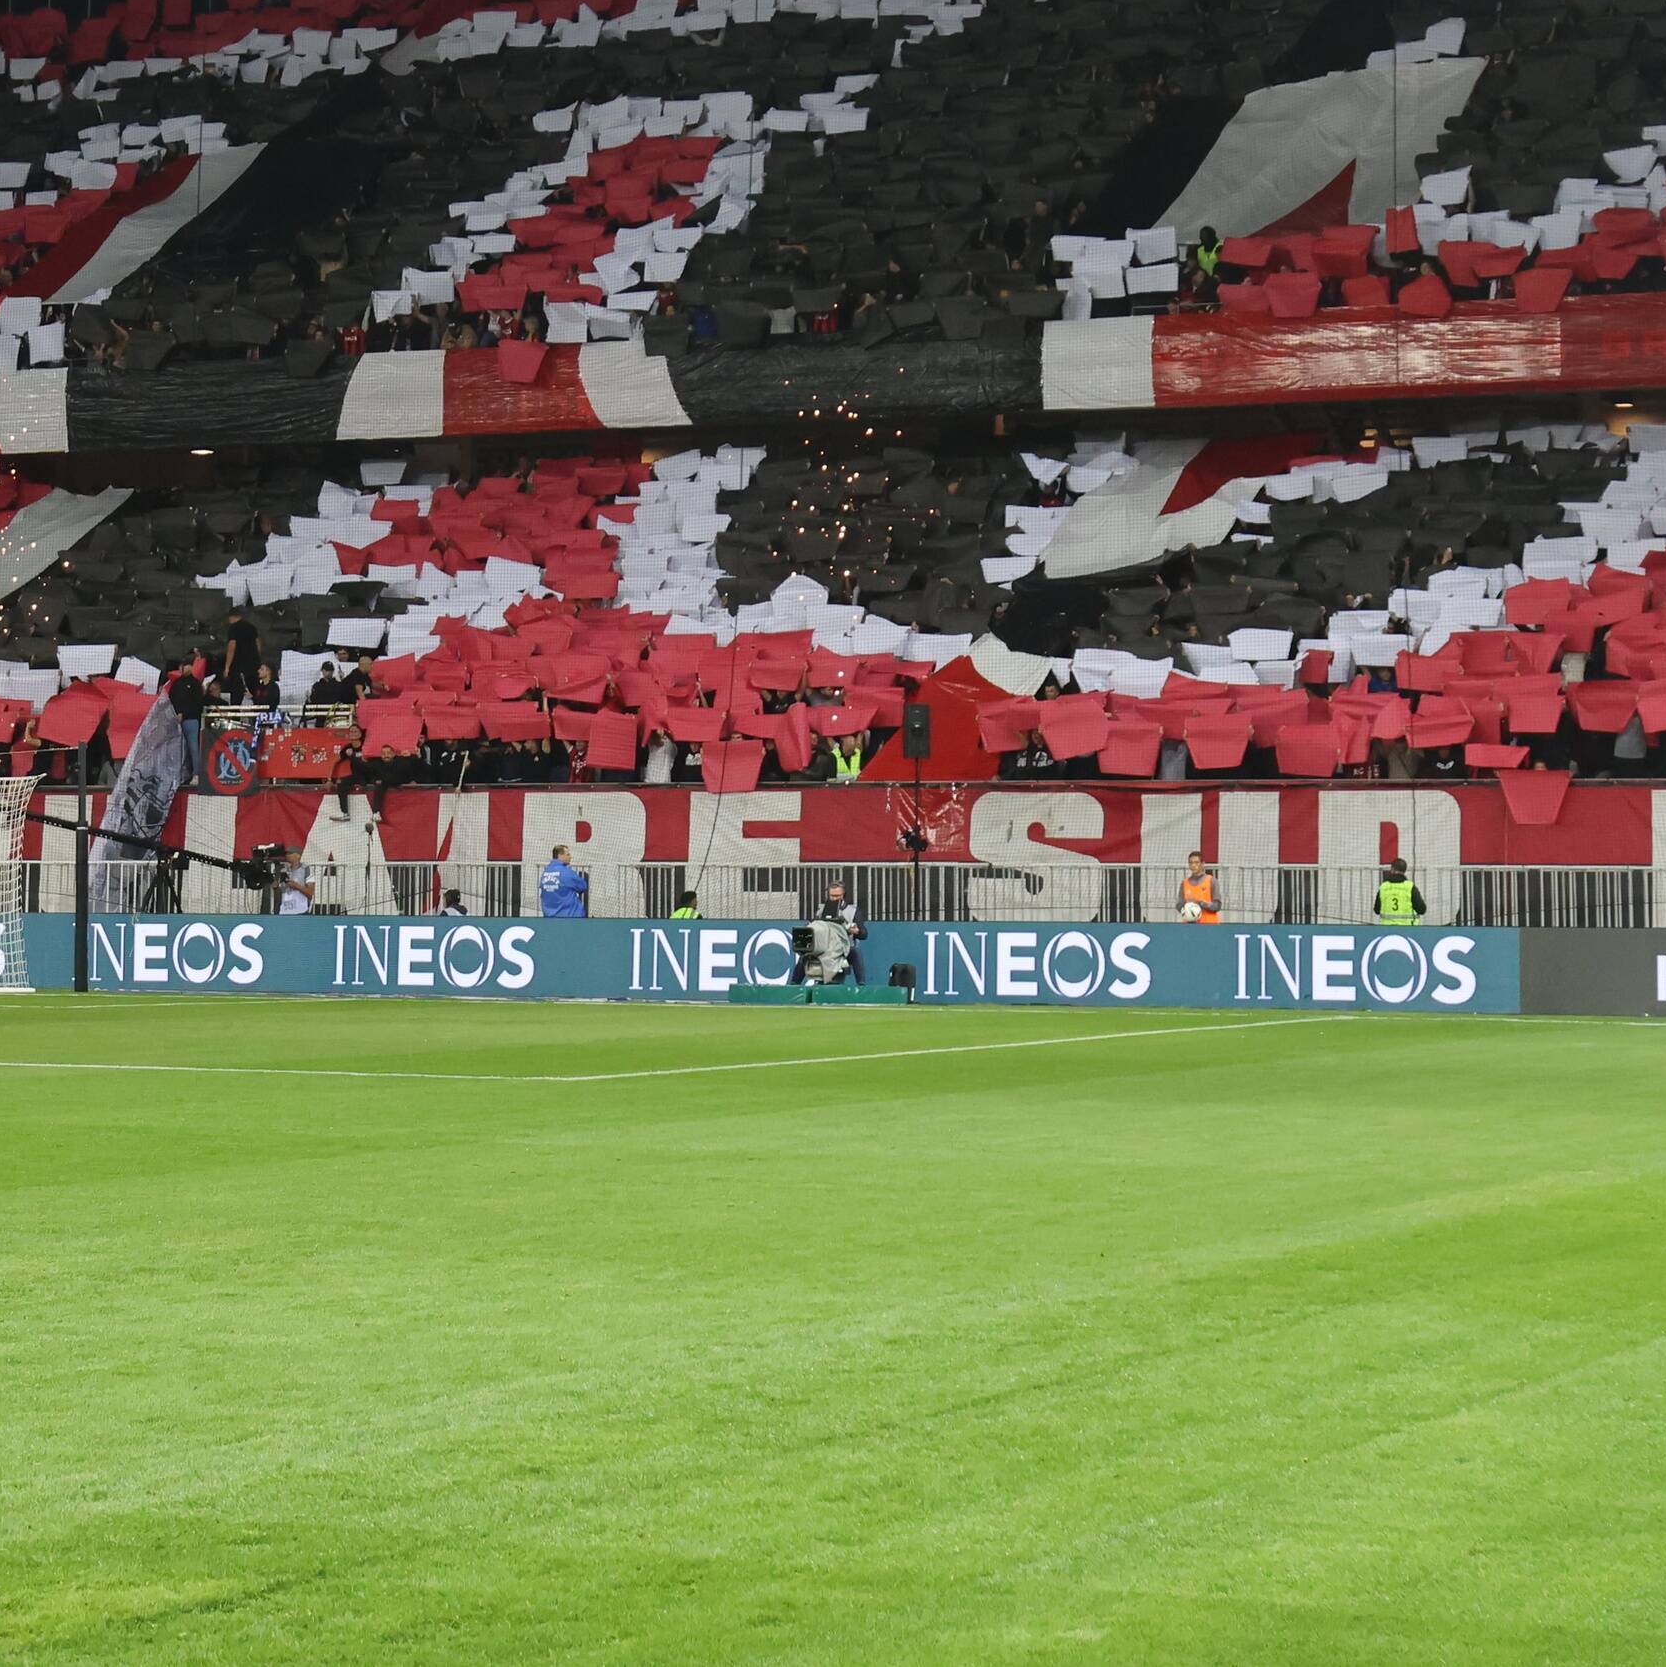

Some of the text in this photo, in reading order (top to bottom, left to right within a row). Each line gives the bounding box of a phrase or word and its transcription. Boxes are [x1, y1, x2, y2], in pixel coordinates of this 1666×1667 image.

[1391, 898, 1399, 911] 3
[71, 922, 264, 985] NEOS
[333, 923, 536, 990] INEOS
[628, 928, 798, 992] INEO
[922, 931, 1152, 999] INEOS
[1235, 934, 1477, 1005] INEOS
